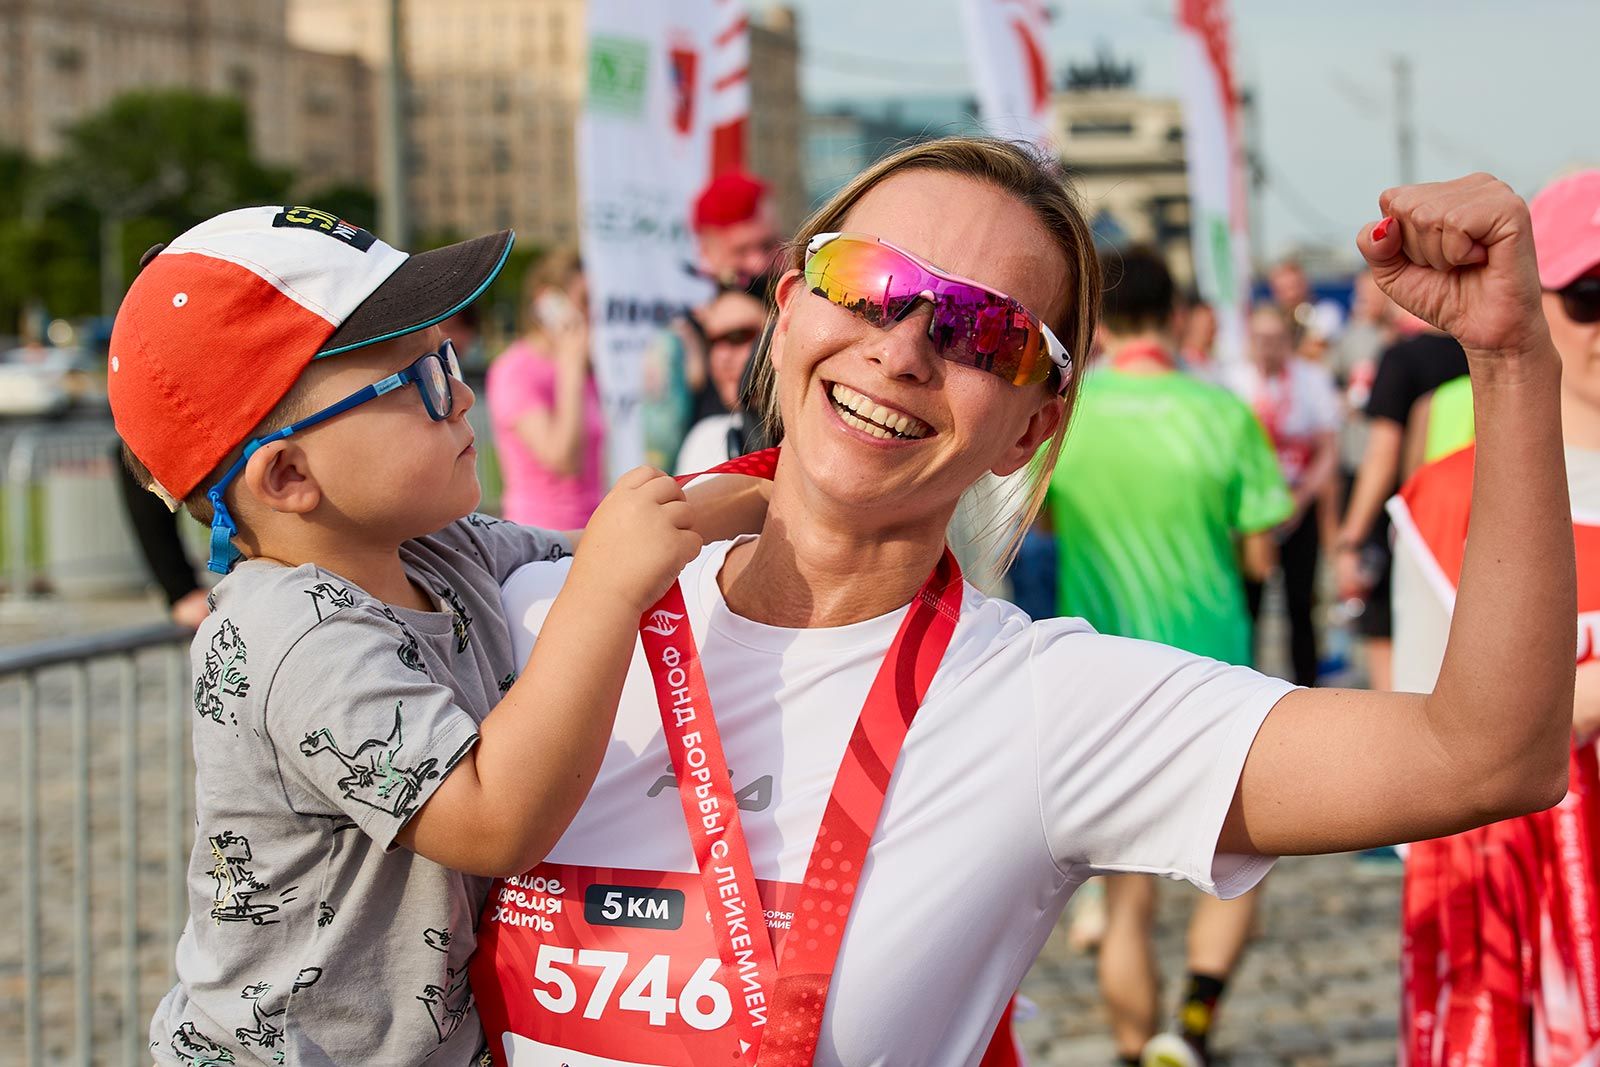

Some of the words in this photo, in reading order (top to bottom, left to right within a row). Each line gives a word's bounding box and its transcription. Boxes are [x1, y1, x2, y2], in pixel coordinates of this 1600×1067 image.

[662, 646, 697, 727] ФОНД
[682, 731, 725, 835] БОРЬБЫ
[710, 840, 729, 859] С
[498, 888, 562, 914] время
[601, 891, 622, 919] 5
[627, 897, 669, 919] КМ
[491, 905, 554, 932] жить
[532, 944, 732, 1031] 5746
